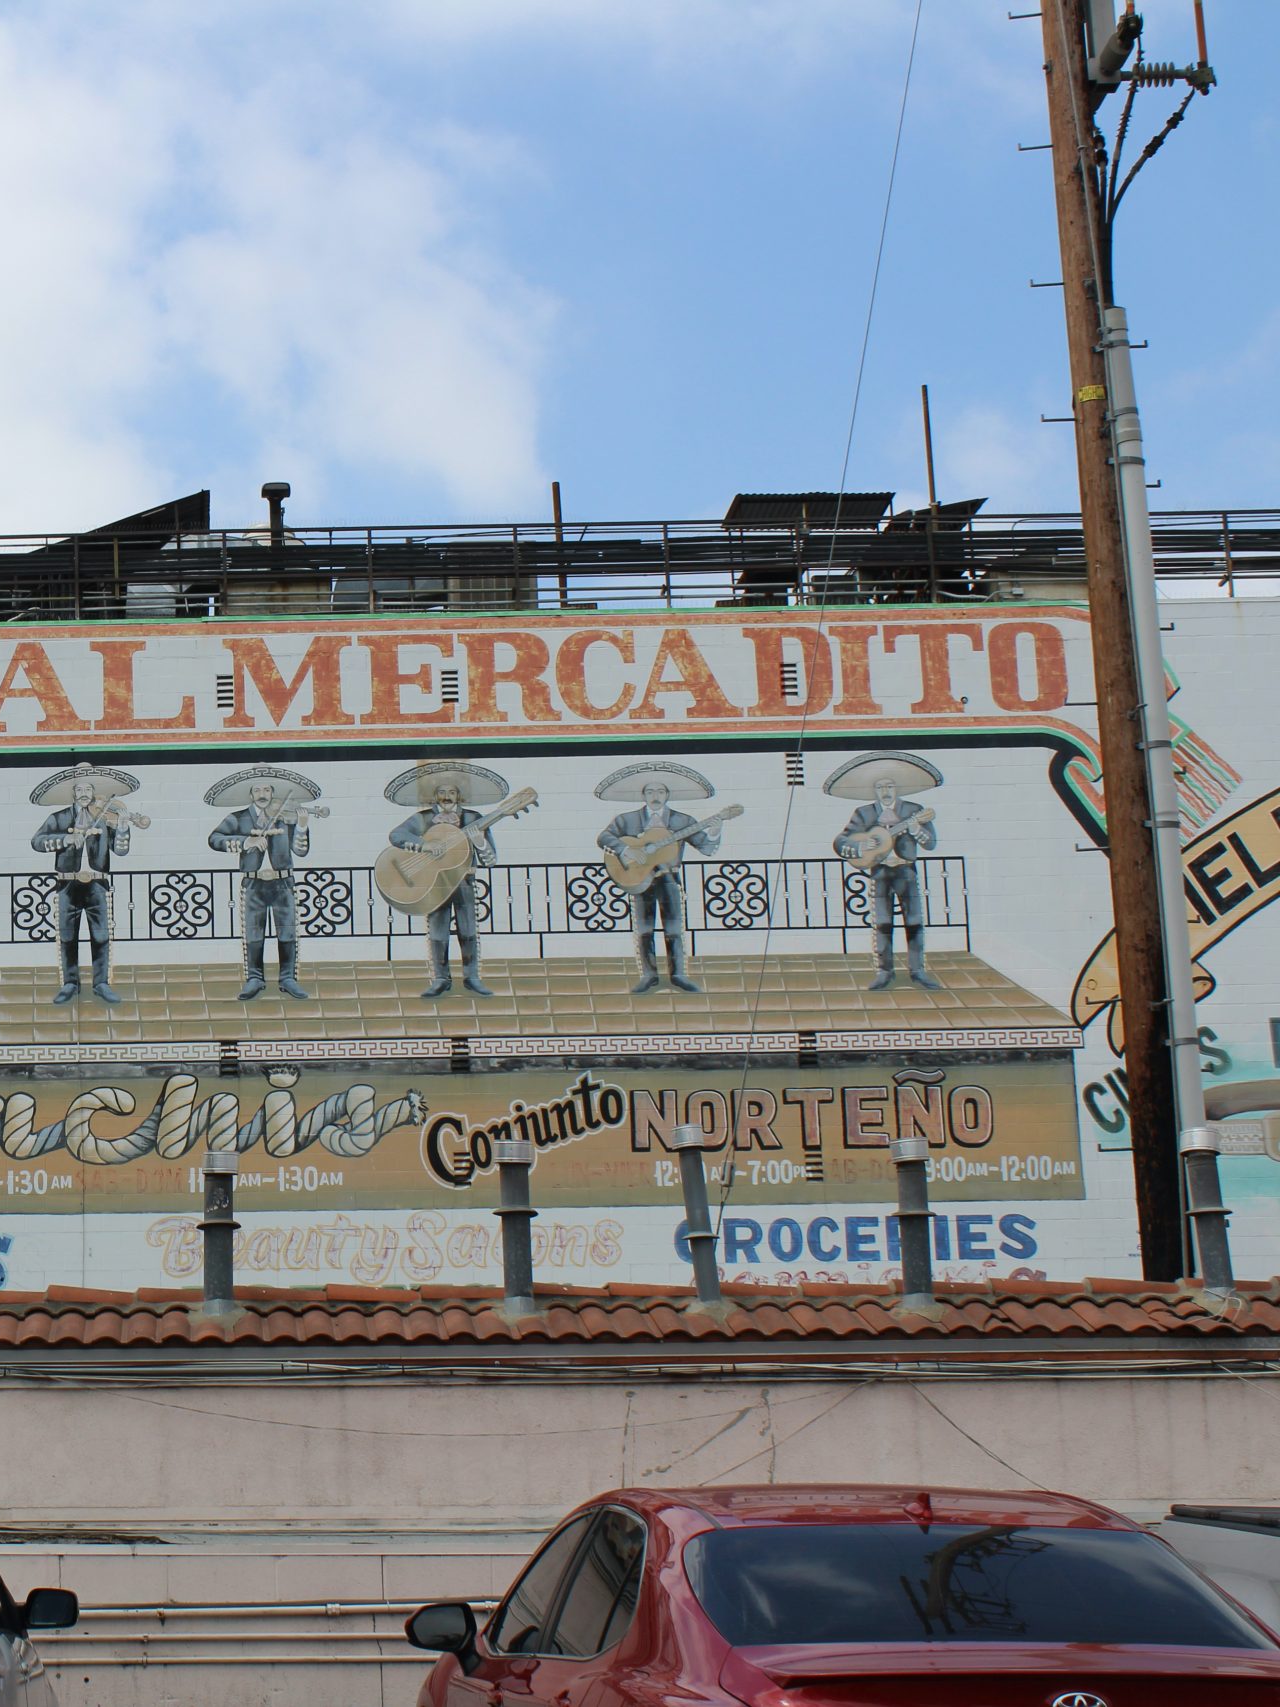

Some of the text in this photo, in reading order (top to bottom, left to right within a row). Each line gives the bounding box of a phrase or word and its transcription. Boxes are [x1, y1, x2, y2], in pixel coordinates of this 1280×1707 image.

[222, 622, 1067, 728] MERCADITO
[631, 1069, 994, 1153] NORTEÑO
[145, 1210, 624, 1286] Bauty Saons
